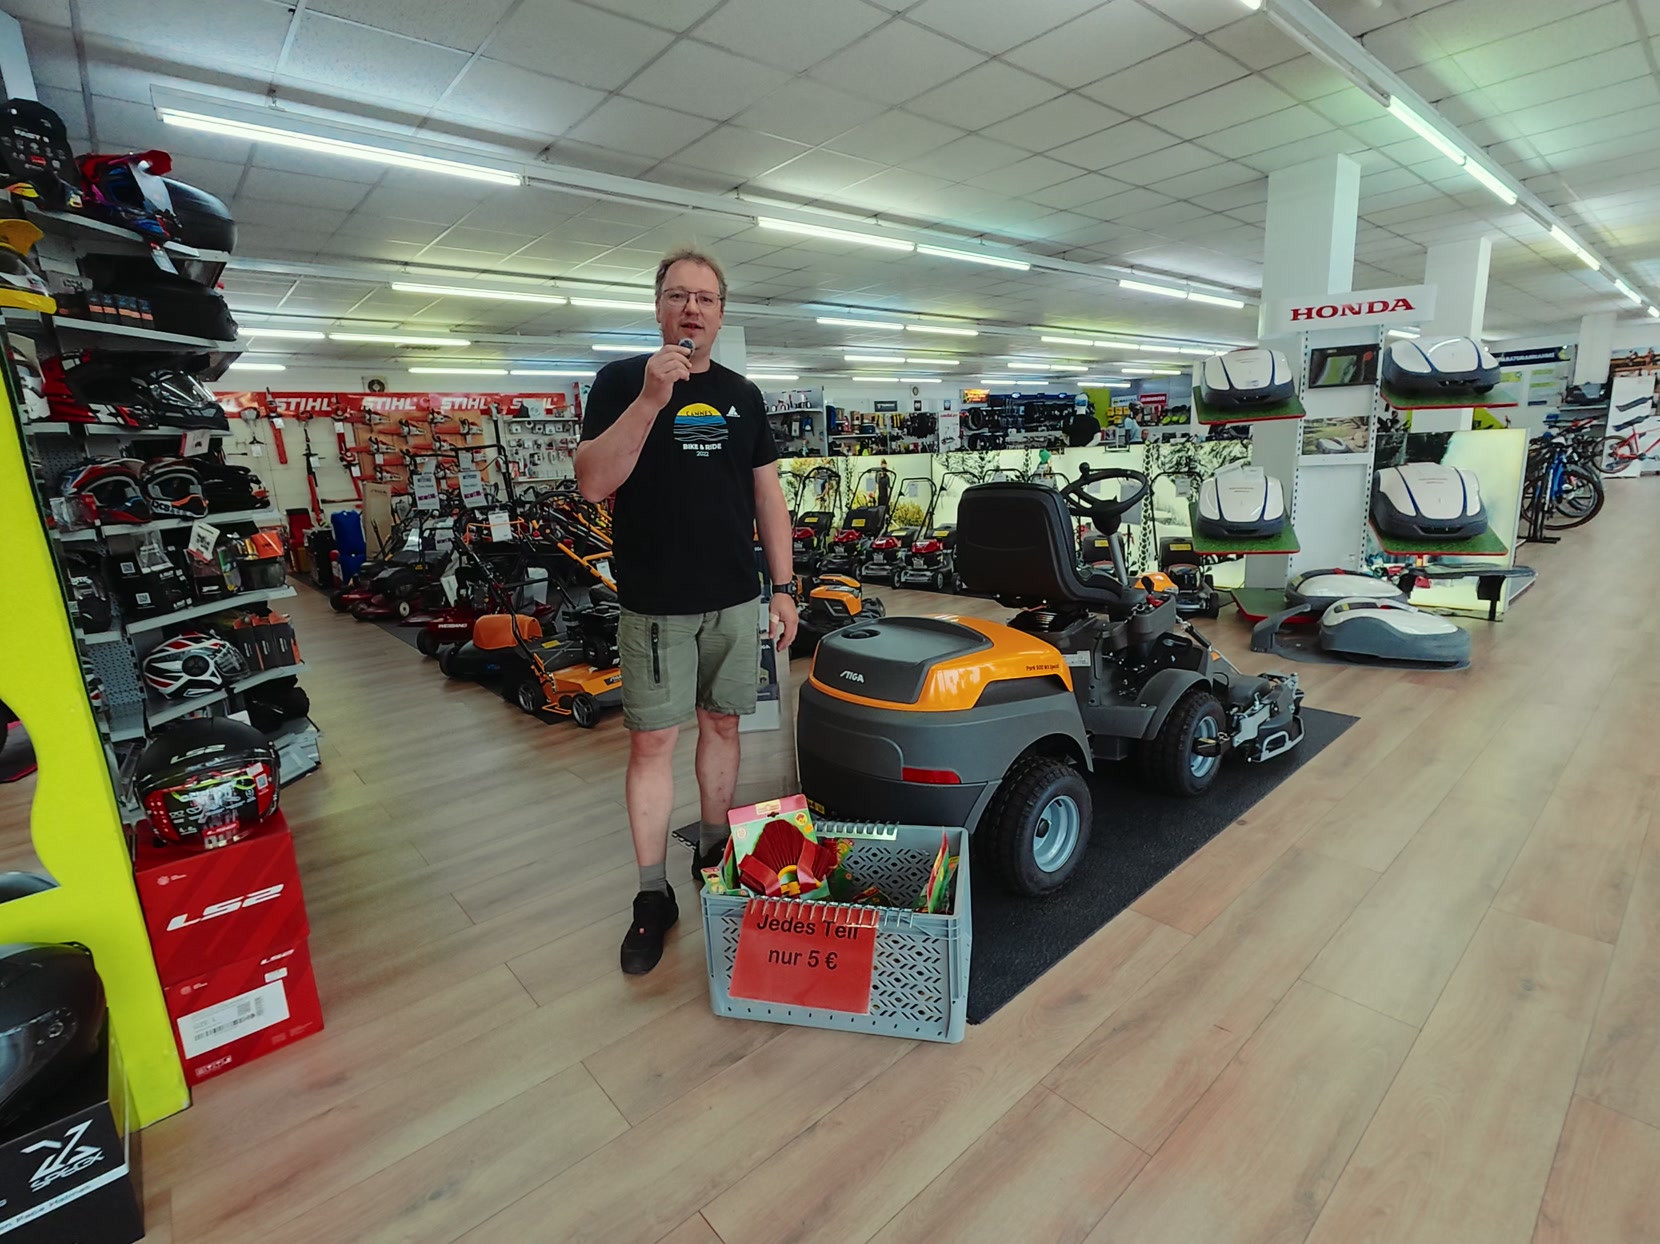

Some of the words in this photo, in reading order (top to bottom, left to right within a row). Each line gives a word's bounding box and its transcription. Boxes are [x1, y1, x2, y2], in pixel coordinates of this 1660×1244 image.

[1290, 298, 1416, 321] HONDA
[273, 397, 332, 411] STIHL
[362, 396, 417, 410] STIHL
[441, 397, 490, 410] STIHL
[840, 670, 865, 684] STIGA
[166, 883, 285, 932] LS2
[757, 914, 816, 936] Jedes
[823, 919, 859, 940] Teil
[768, 949, 802, 967] nur
[807, 949, 820, 968] 5
[825, 951, 838, 970] €
